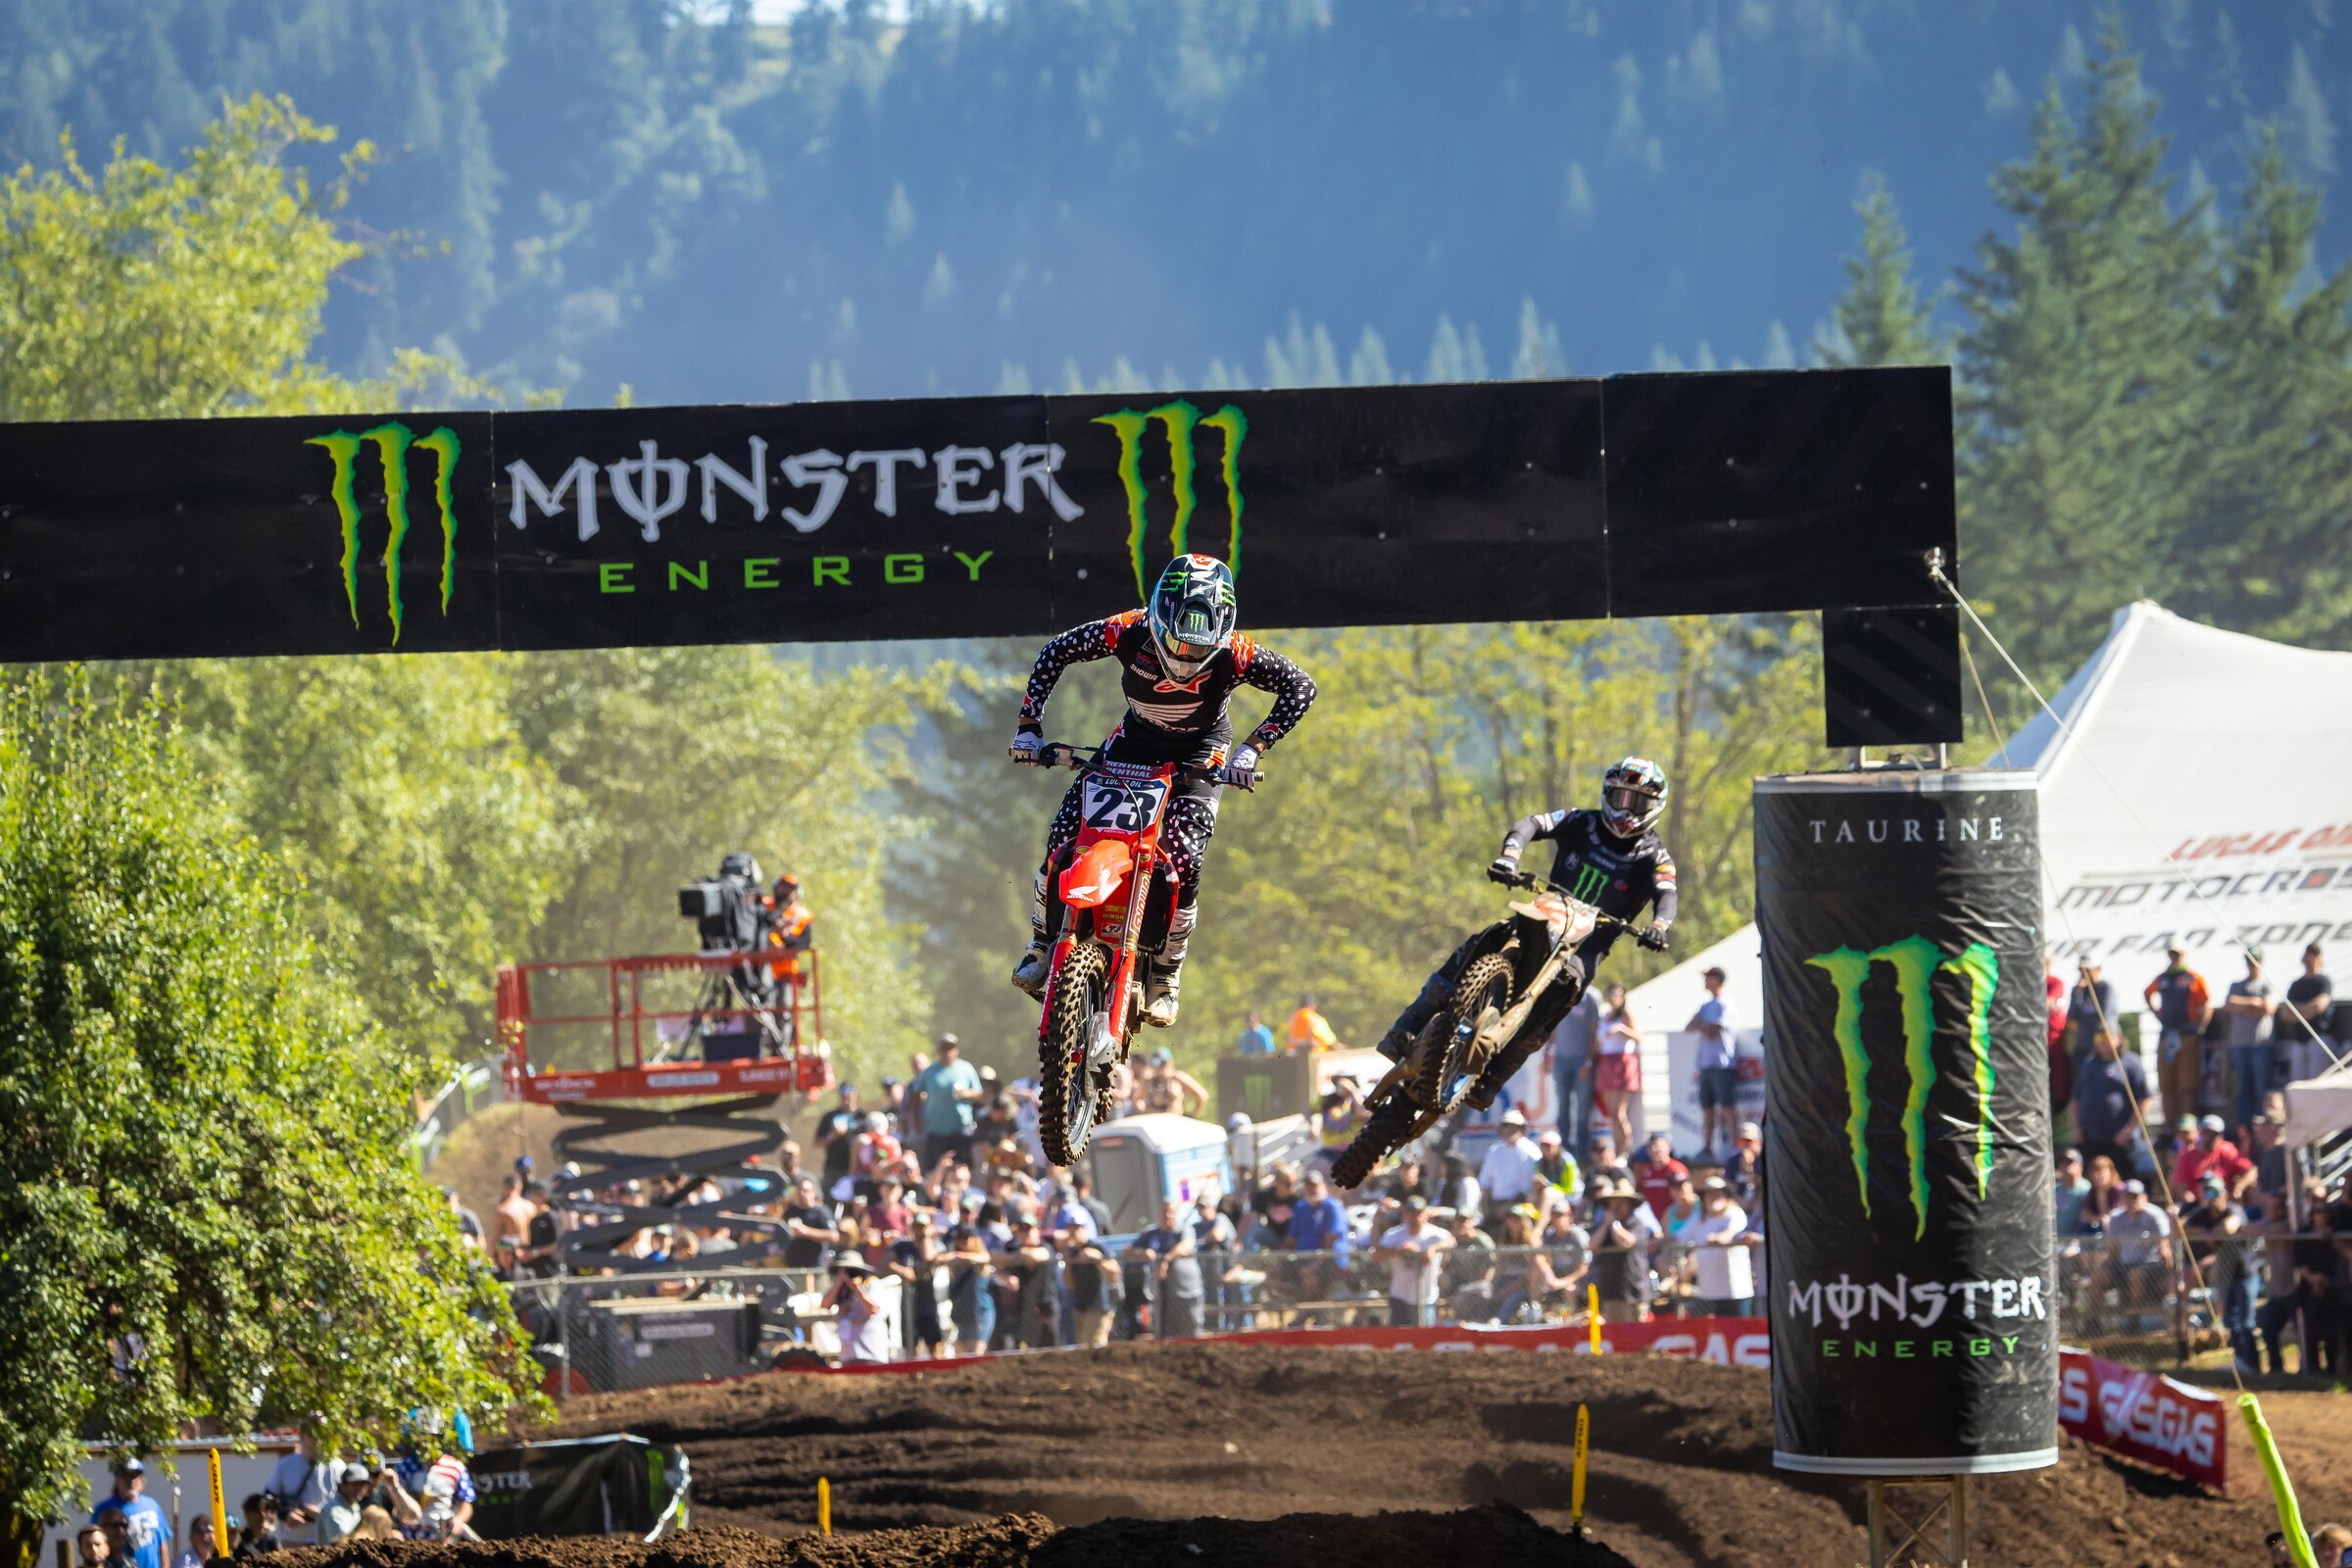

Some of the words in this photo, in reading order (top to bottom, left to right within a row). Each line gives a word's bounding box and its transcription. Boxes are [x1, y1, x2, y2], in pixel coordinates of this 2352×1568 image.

[505, 435, 1085, 543] MONSTER
[599, 550, 994, 594] ENERGY
[1129, 662, 1158, 681] SHOWA
[1086, 788, 1156, 832] 23
[1809, 815, 2003, 843] TAURINE
[2164, 828, 2301, 862] LUCAS
[1066, 894, 1095, 903] HONDA
[1118, 970, 1132, 1035] DUNLOP
[1788, 1273, 2046, 1331] MONSTER
[1822, 1336, 2019, 1358] ENERGY
[2098, 1380, 2218, 1467] GASGAS
